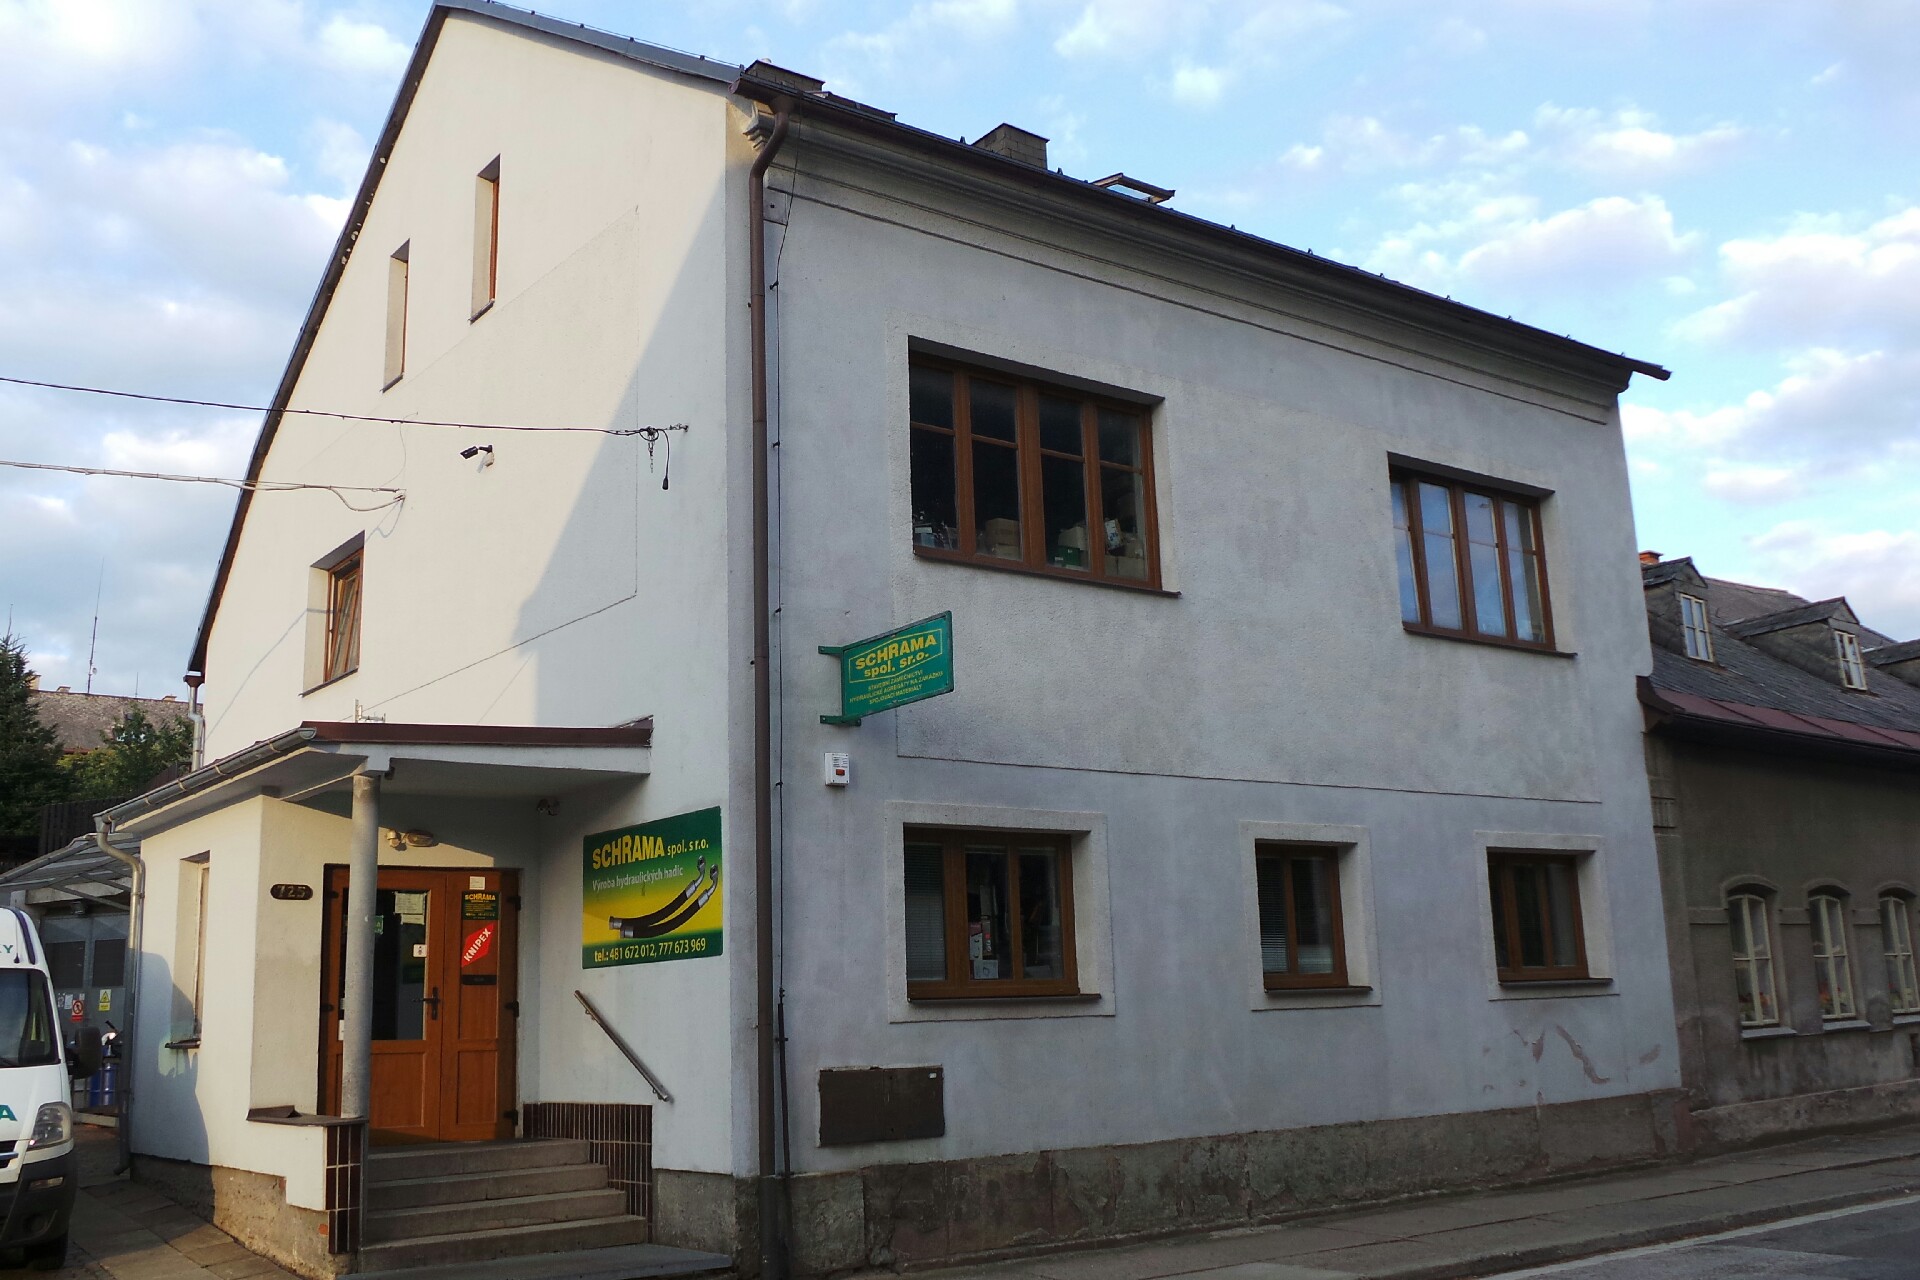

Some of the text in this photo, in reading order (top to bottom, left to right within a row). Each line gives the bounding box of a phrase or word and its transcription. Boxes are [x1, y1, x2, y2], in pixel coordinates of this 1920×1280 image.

[856, 634, 937, 669] SCHRAMA
[864, 659, 895, 678] spol.
[592, 835, 665, 870] SCHRAMA
[667, 839, 687, 858] spol.
[592, 865, 683, 892] Výroba hydraulických hadic
[464, 893, 496, 901] SCHRAMA
[0, 944, 14, 954] Y
[463, 927, 492, 962] KNIPEX
[594, 937, 706, 962] tel.: 481 672 012, 777 673 969
